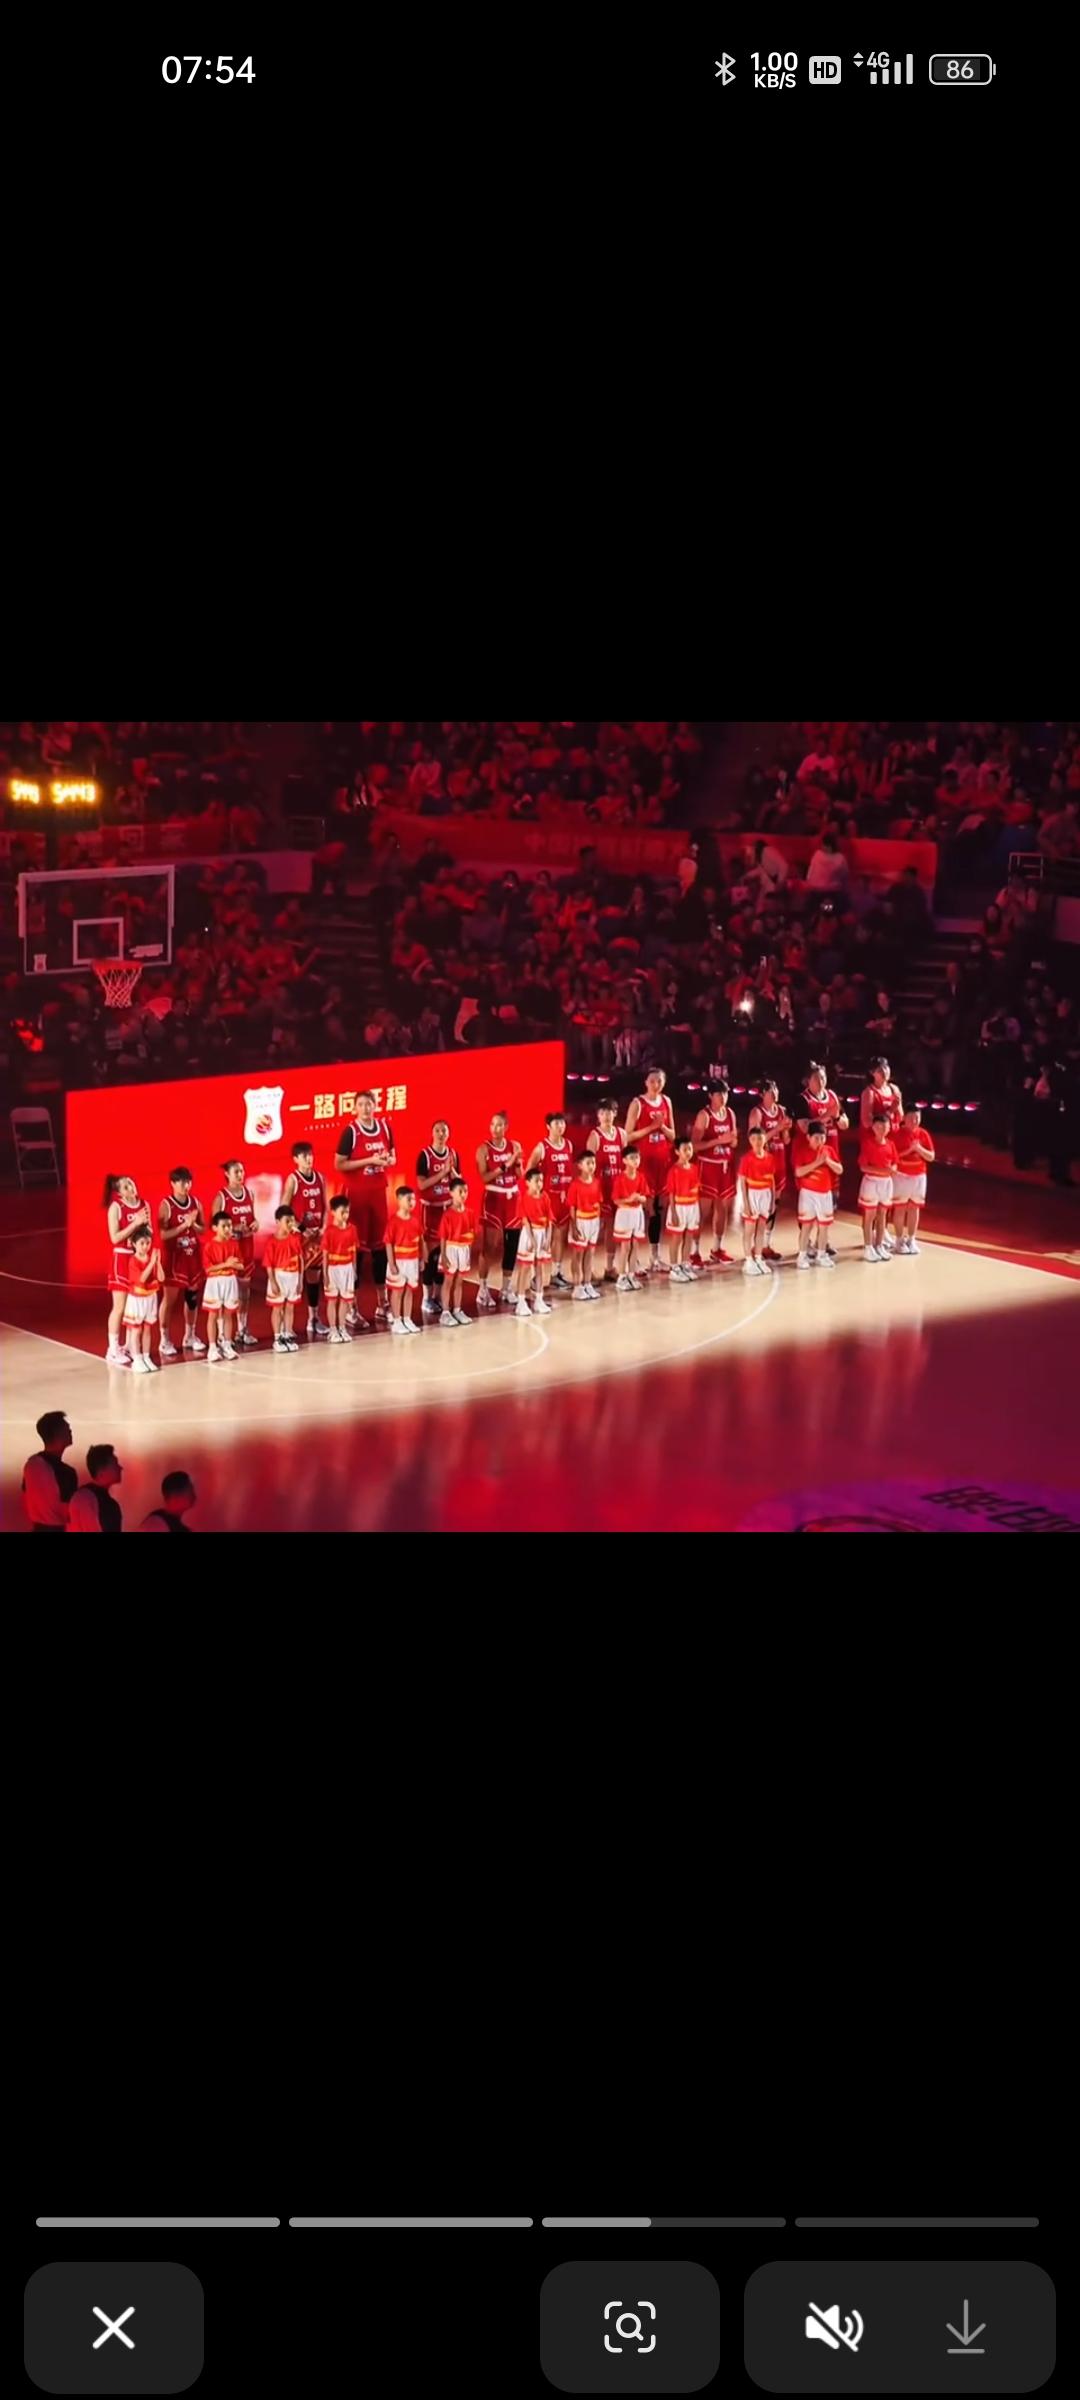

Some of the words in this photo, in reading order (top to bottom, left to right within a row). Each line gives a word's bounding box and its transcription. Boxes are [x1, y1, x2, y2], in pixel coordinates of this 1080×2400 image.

[603, 1144, 621, 1153] CHINA
[557, 1163, 566, 1173] 12
[309, 1198, 316, 1209] 6
